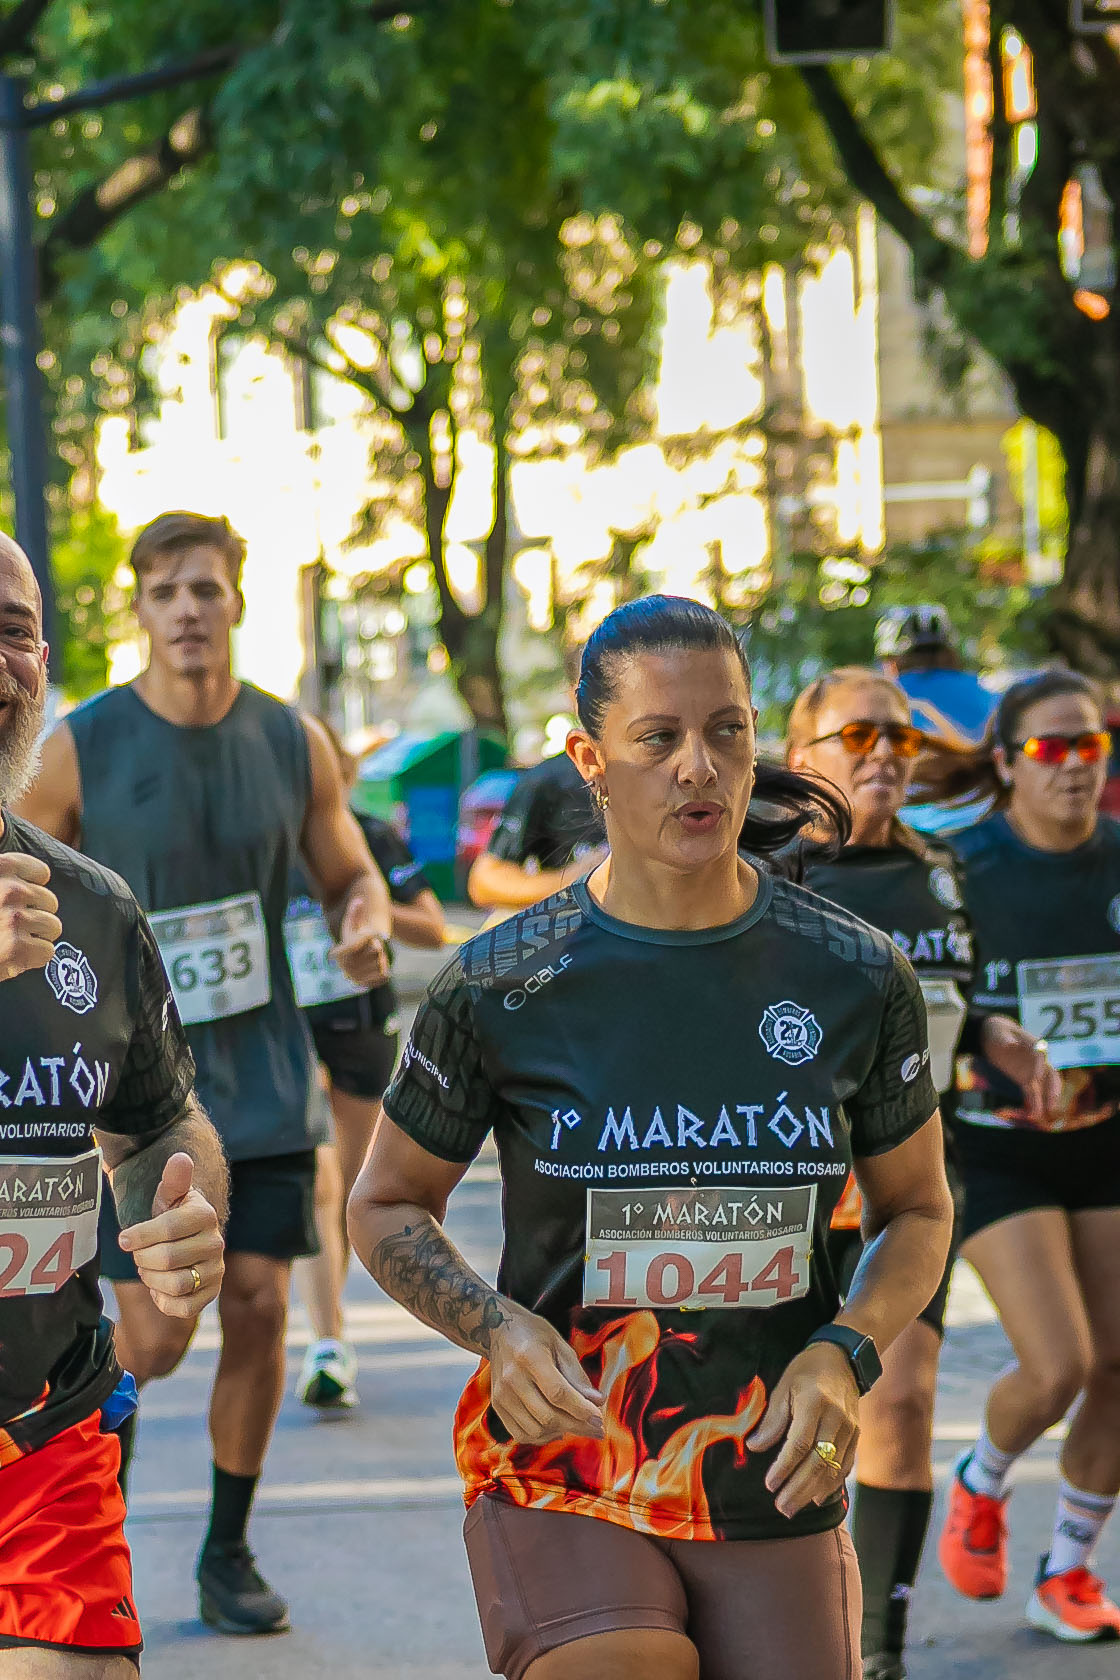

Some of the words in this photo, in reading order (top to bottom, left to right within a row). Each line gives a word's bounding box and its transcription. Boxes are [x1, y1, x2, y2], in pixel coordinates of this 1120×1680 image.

[171, 941, 254, 992] 633
[597, 1090, 834, 1151] MARATÓN
[534, 1158, 604, 1178] ASOCIACIÓN
[607, 1161, 690, 1177] BOMBEROS
[692, 1160, 794, 1176] VOLUNTARIOS
[796, 1161, 846, 1176] ROSARIO
[19, 1206, 71, 1217] VOLUNTARIOS
[652, 1194, 783, 1227] MARATÓN
[598, 1228, 652, 1240] ASOCIACIÓN
[654, 1229, 703, 1240] BOMBEROS
[705, 1229, 765, 1241] VOLUNTARIOS
[766, 1223, 803, 1239] ROSARIO
[595, 1245, 800, 1305] 1044
